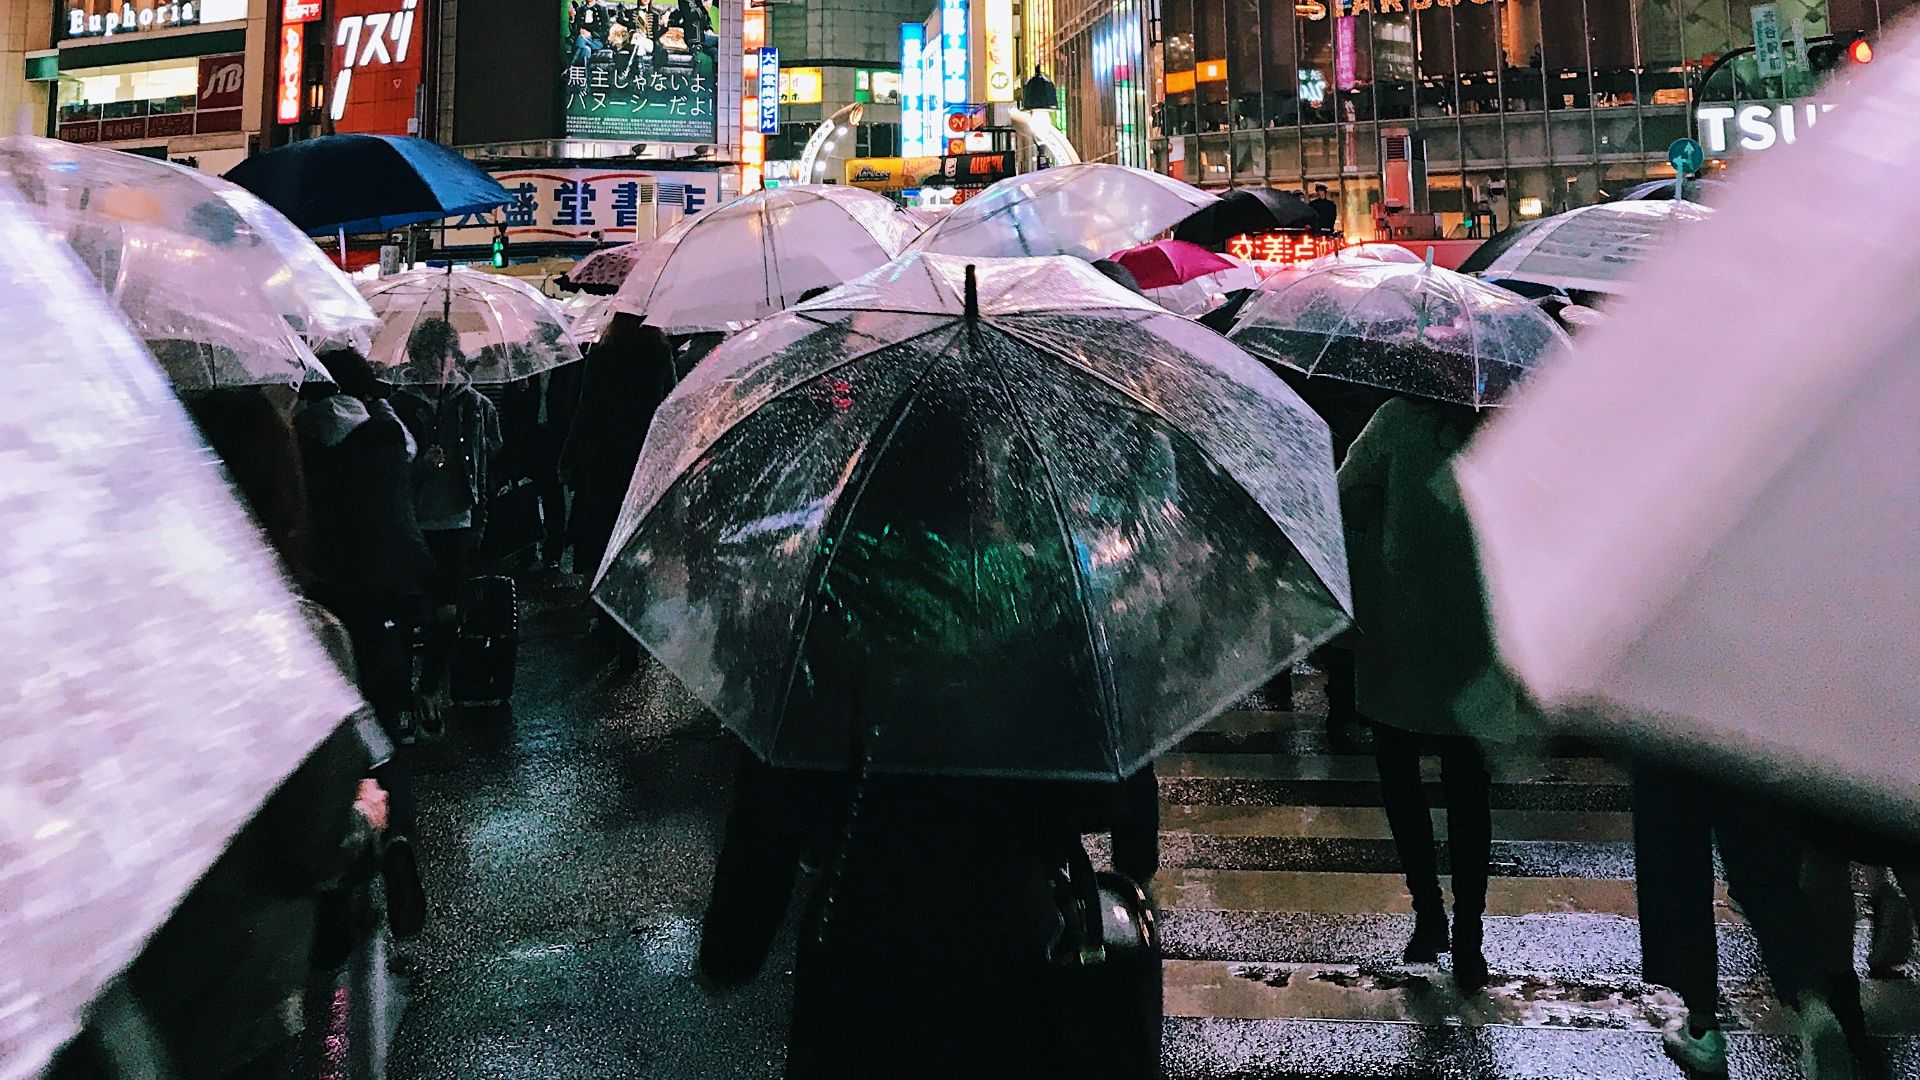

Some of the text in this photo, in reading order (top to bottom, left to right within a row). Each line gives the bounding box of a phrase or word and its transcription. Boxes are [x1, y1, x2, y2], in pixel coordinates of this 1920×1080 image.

[69, 0, 194, 36] Euphoria
[202, 63, 245, 100] JTB
[567, 65, 713, 93] 馬主じゃないよ、
[1697, 104, 1839, 151] TSU
[1231, 233, 1315, 266] 交差点
